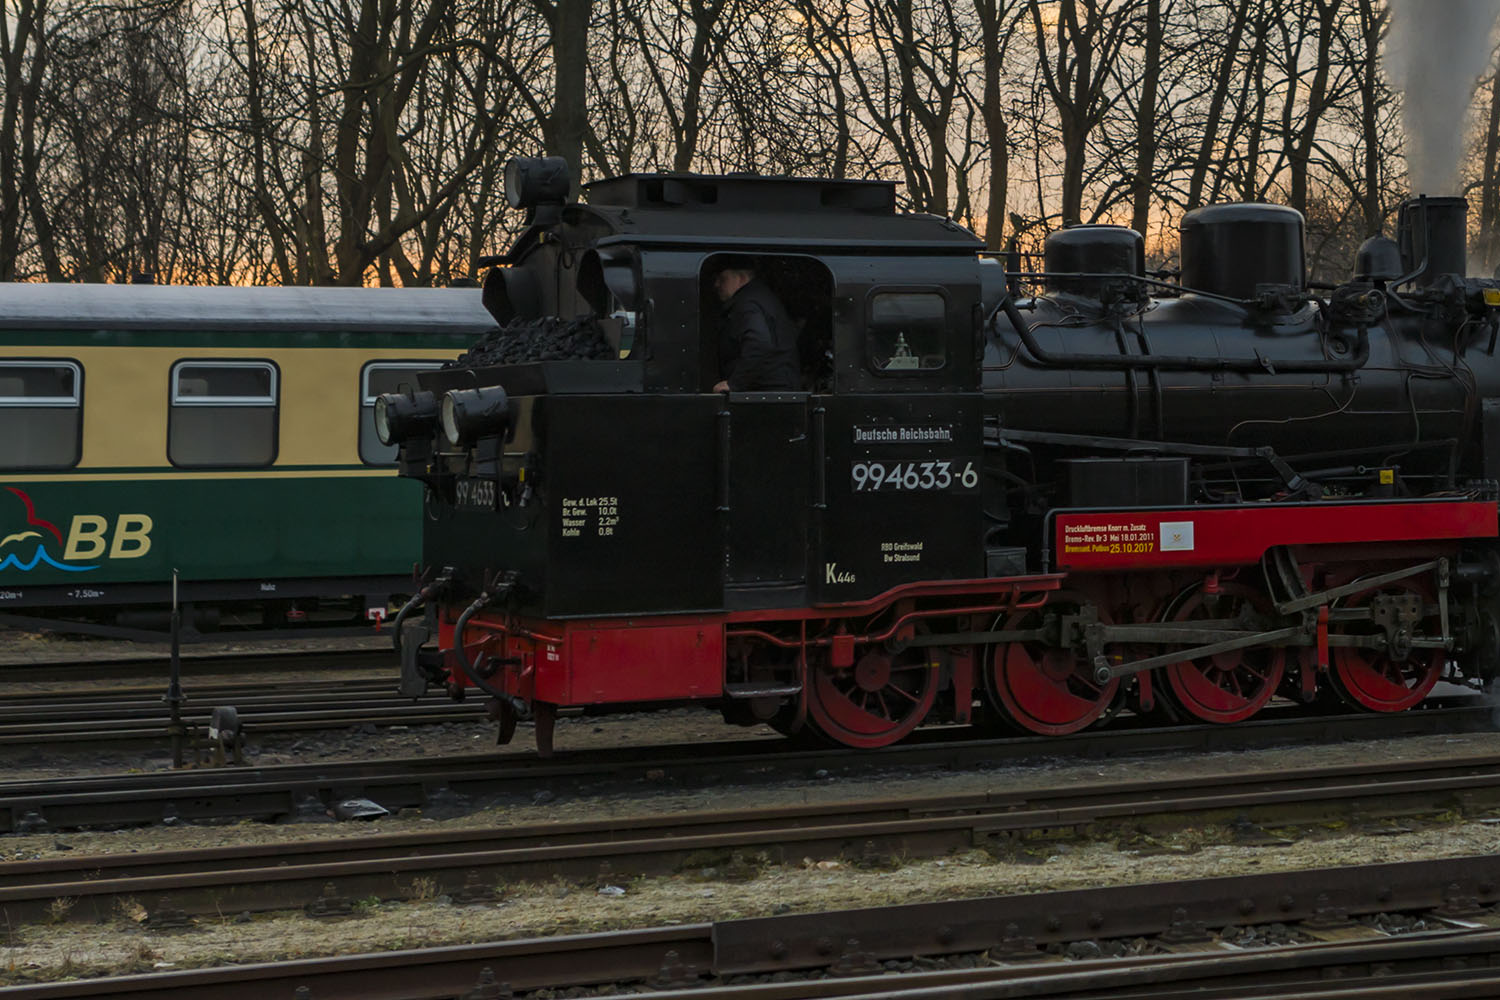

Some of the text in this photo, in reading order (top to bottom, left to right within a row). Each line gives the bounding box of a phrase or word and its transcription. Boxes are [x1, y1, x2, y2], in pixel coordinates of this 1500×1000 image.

[856, 427, 950, 440] Deutsche Reichsbahn
[562, 518, 586, 527] Wasser
[562, 528, 580, 537] Kohle
[1108, 524, 1122, 532] Knorr
[63, 513, 153, 560] BB
[1121, 533, 1154, 541] 18.01.2011
[894, 542, 923, 551] Greifswald
[1110, 543, 1154, 553] 25.10.2017
[894, 553, 920, 562] Stralsund
